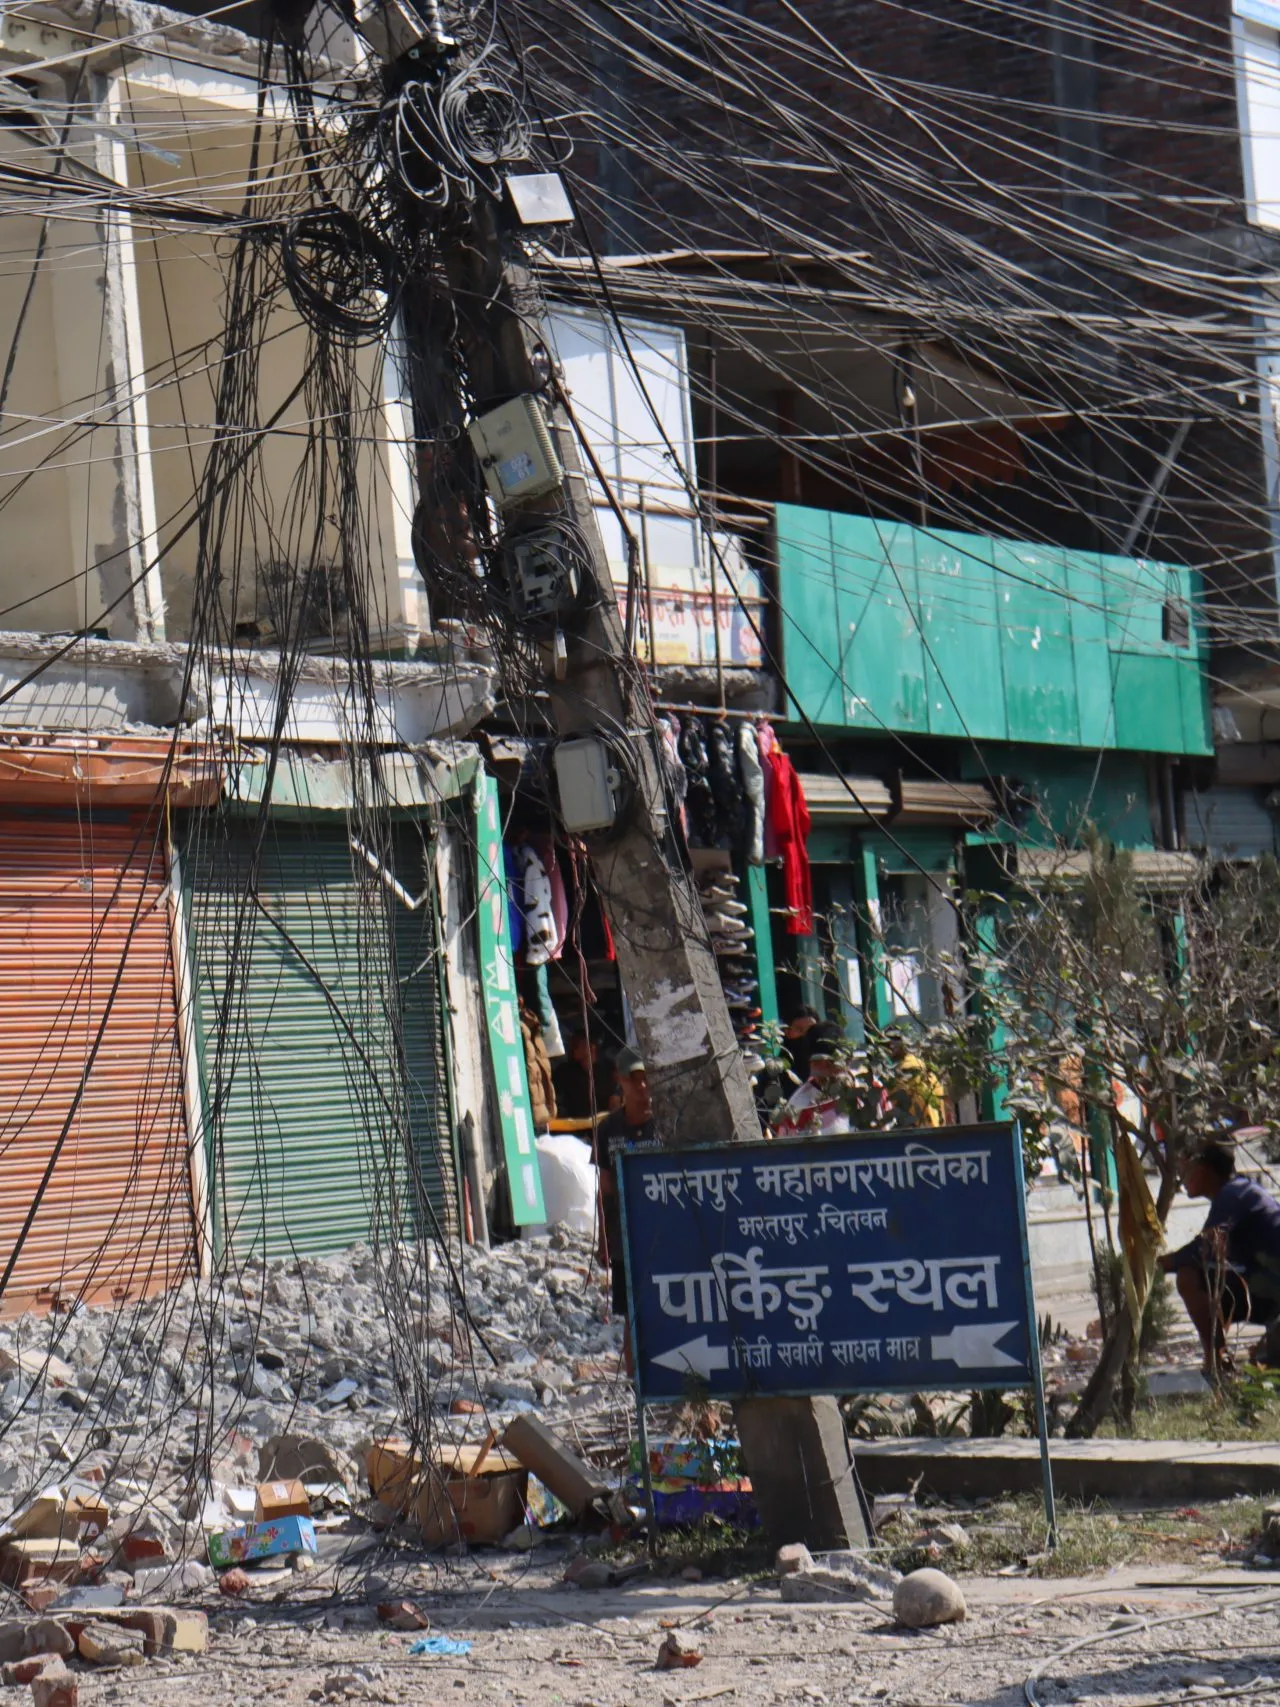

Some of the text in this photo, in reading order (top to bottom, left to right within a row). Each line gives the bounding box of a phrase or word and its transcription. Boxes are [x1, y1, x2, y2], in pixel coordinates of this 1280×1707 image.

[485, 961, 505, 1040] ATM
[642, 1143, 992, 1213] भरतपुर महानगरपालिका
[737, 1213, 808, 1246] भरतपुर
[847, 1255, 1001, 1314] स्थल
[732, 1334, 921, 1369] निजी सवारी साधन मात्र
